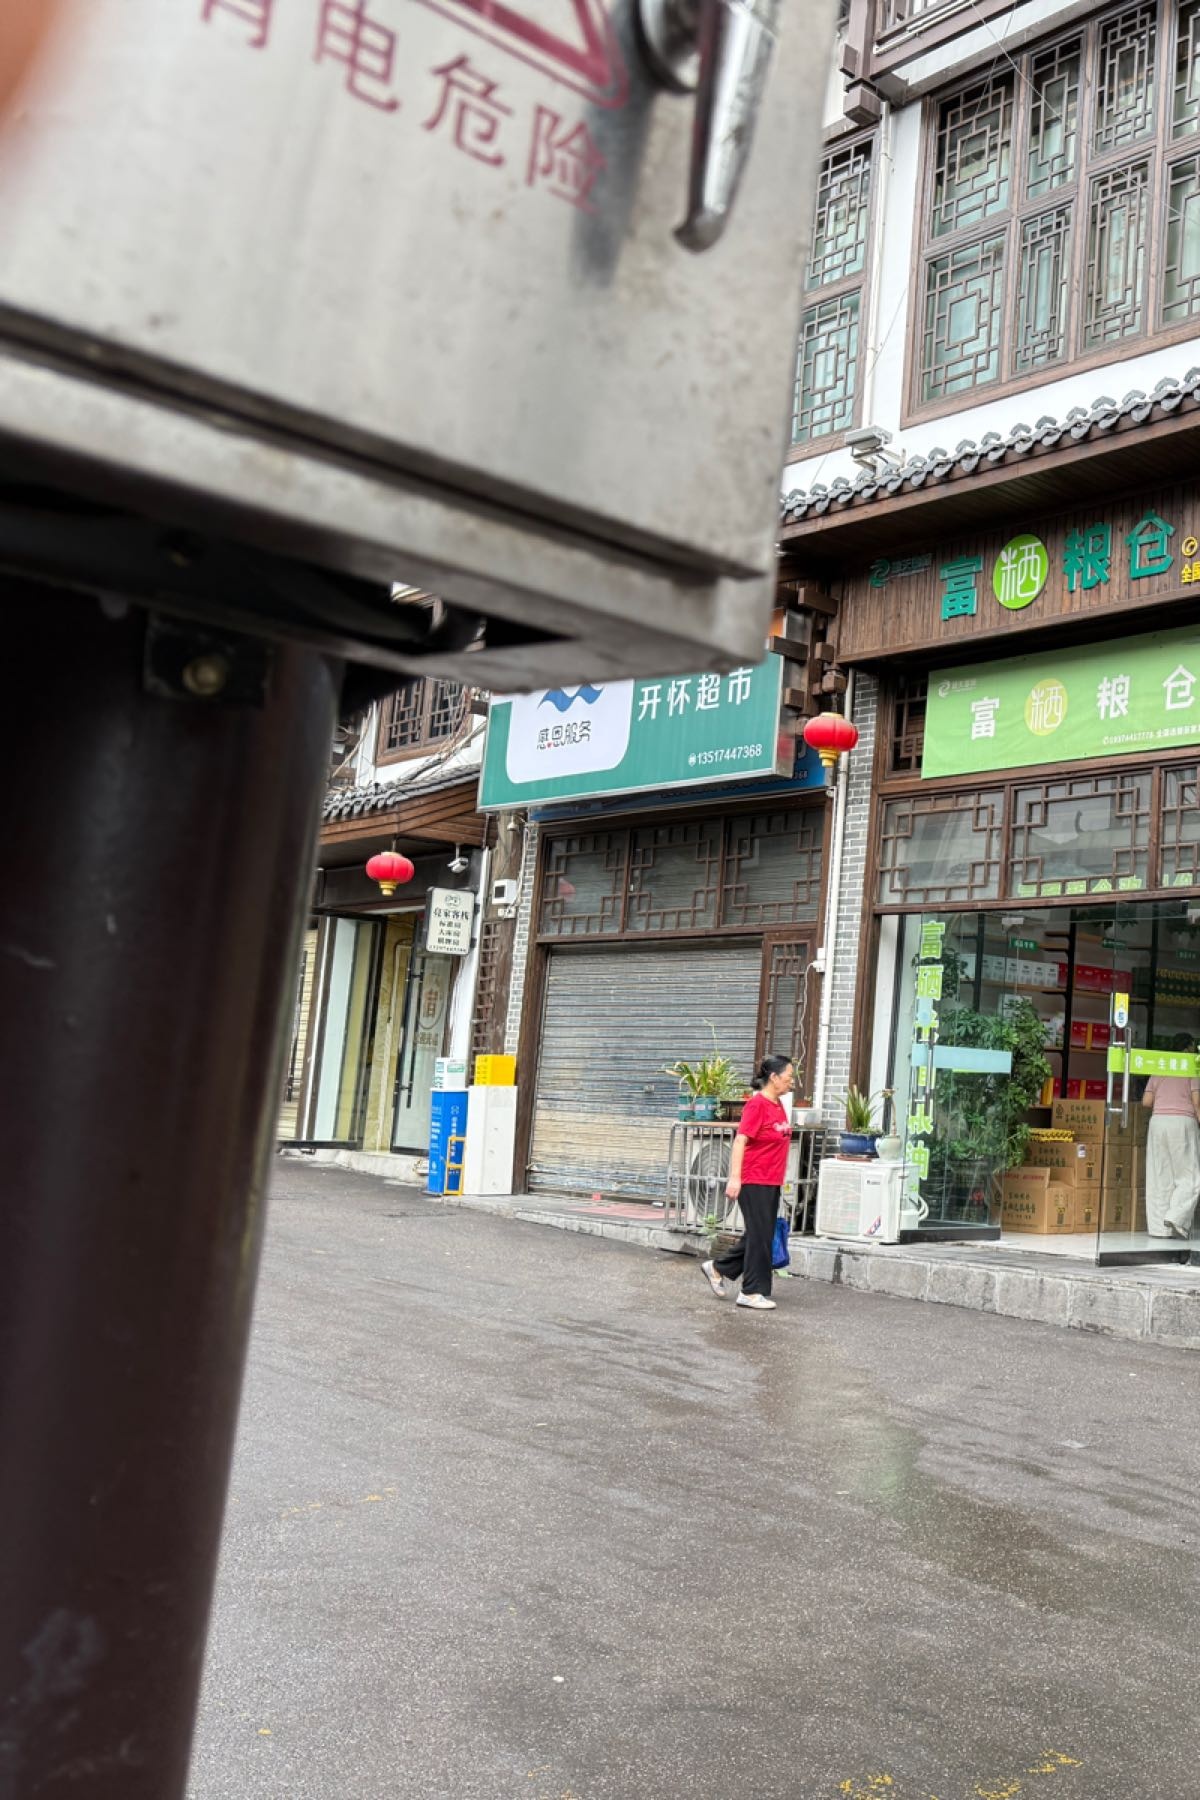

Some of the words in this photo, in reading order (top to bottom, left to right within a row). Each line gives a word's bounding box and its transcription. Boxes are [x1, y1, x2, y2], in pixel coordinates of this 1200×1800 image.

[638, 667, 754, 722] 开怀超市
[537, 720, 592, 750] 感恩服务
[697, 743, 763, 766] 13517447368
